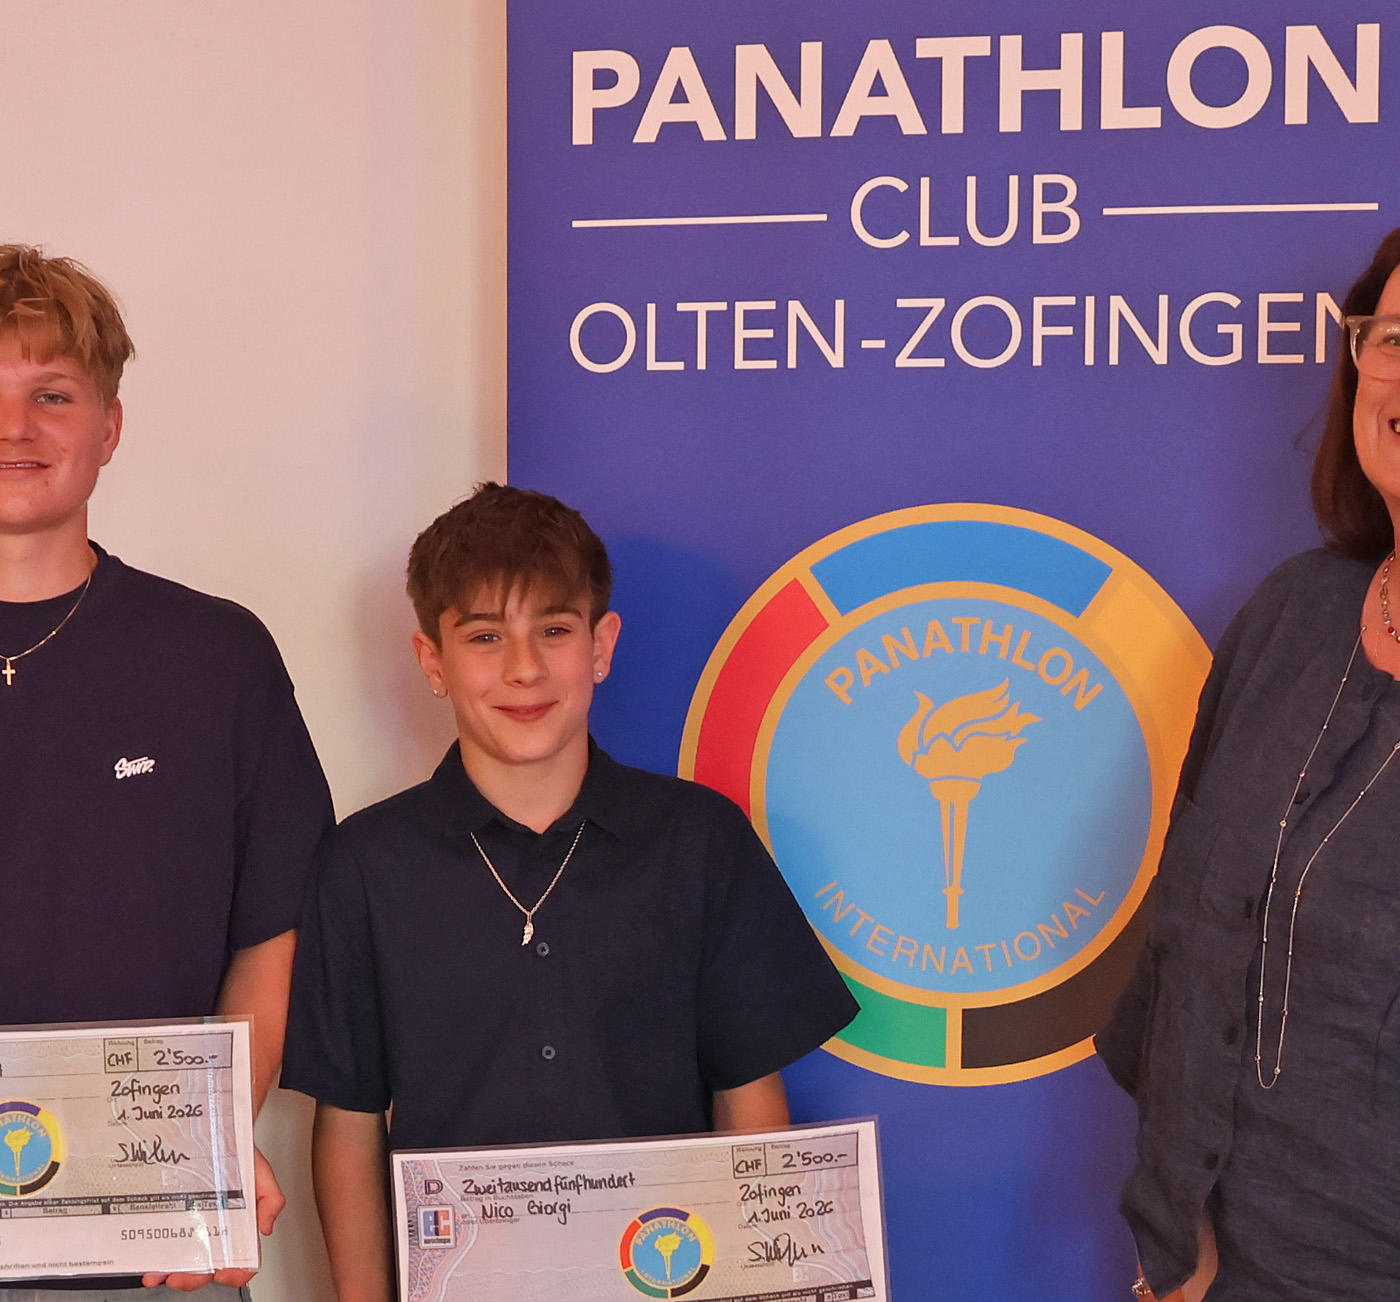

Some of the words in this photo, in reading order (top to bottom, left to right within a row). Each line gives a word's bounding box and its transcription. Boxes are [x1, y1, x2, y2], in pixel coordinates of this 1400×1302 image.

[571, 22, 1381, 146] PANATHLON
[850, 173, 1081, 249] CLUB
[823, 616, 1104, 711] PANATHLON
[813, 880, 1106, 975] INTERNATIONAL
[107, 1052, 133, 1067] CHF
[111, 1078, 180, 1104] Zofingen
[131, 1105, 163, 1121] Juni
[167, 1104, 204, 1119] 2026
[735, 1159, 762, 1173] CHF
[740, 1183, 801, 1206] Zofingen
[481, 1202, 514, 1220] Nico
[761, 1205, 791, 1223] Juni
[796, 1200, 834, 1219] 2026
